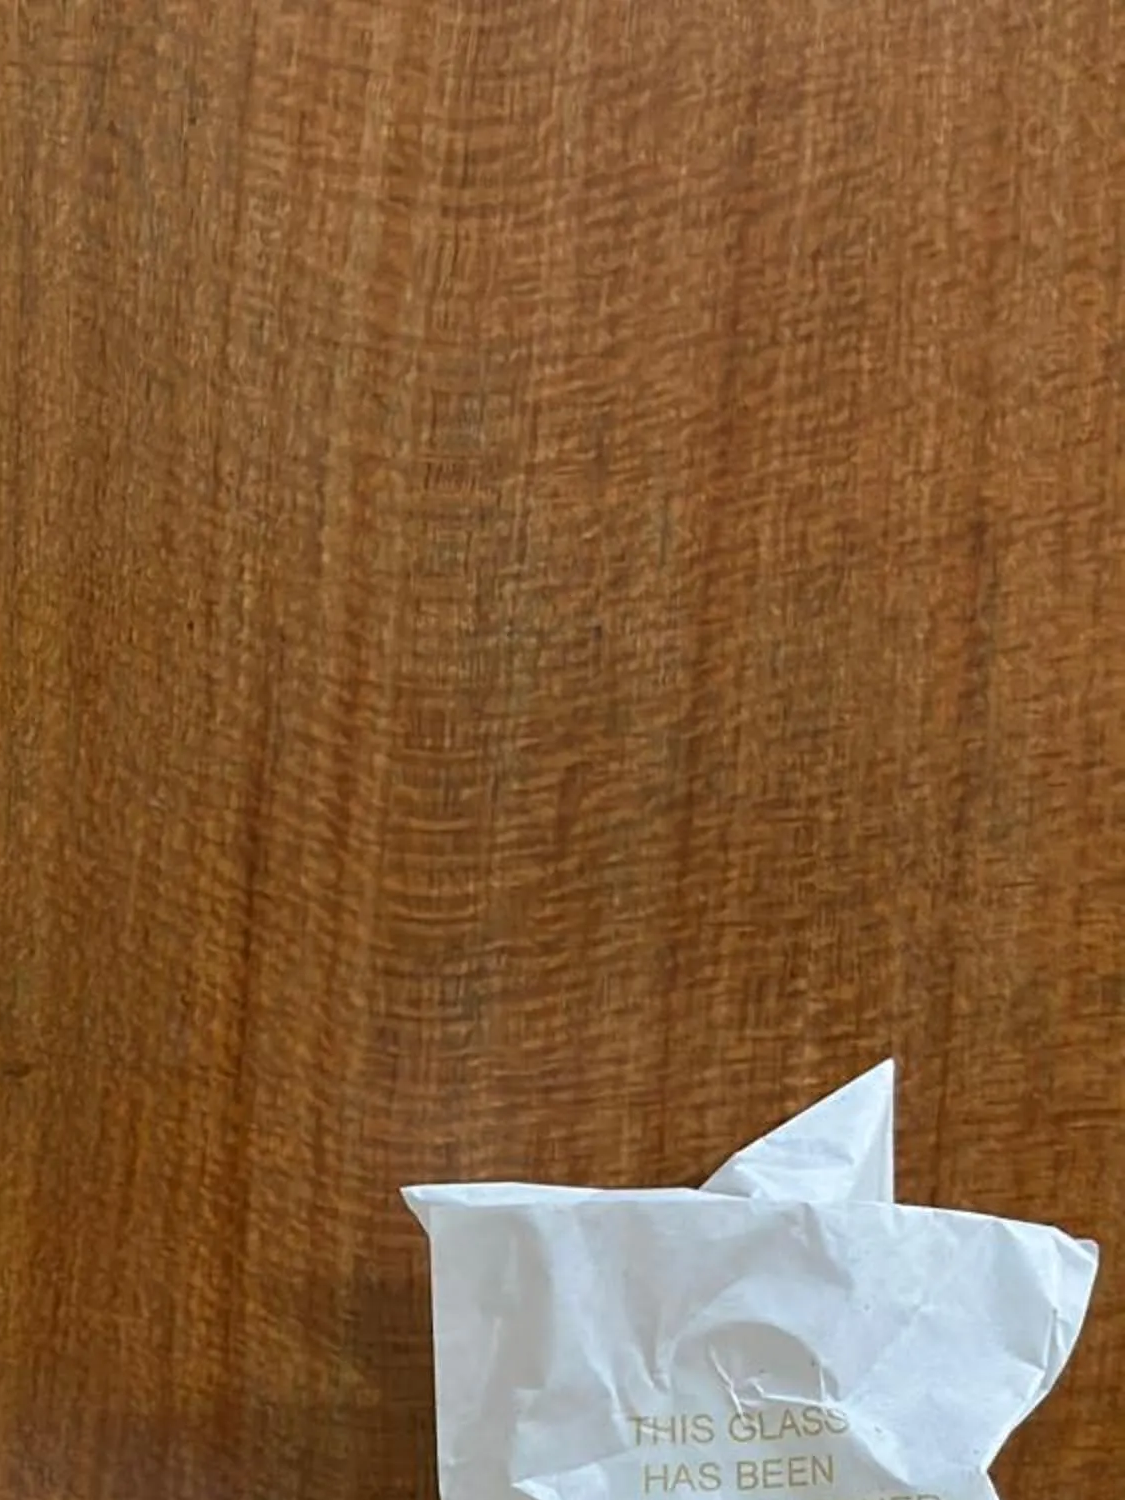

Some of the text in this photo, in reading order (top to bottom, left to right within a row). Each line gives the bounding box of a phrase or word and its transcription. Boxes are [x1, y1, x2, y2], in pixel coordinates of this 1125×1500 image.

[629, 1406, 851, 1446] THIS GLASS
[643, 1455, 834, 1493] HAS BEEN
